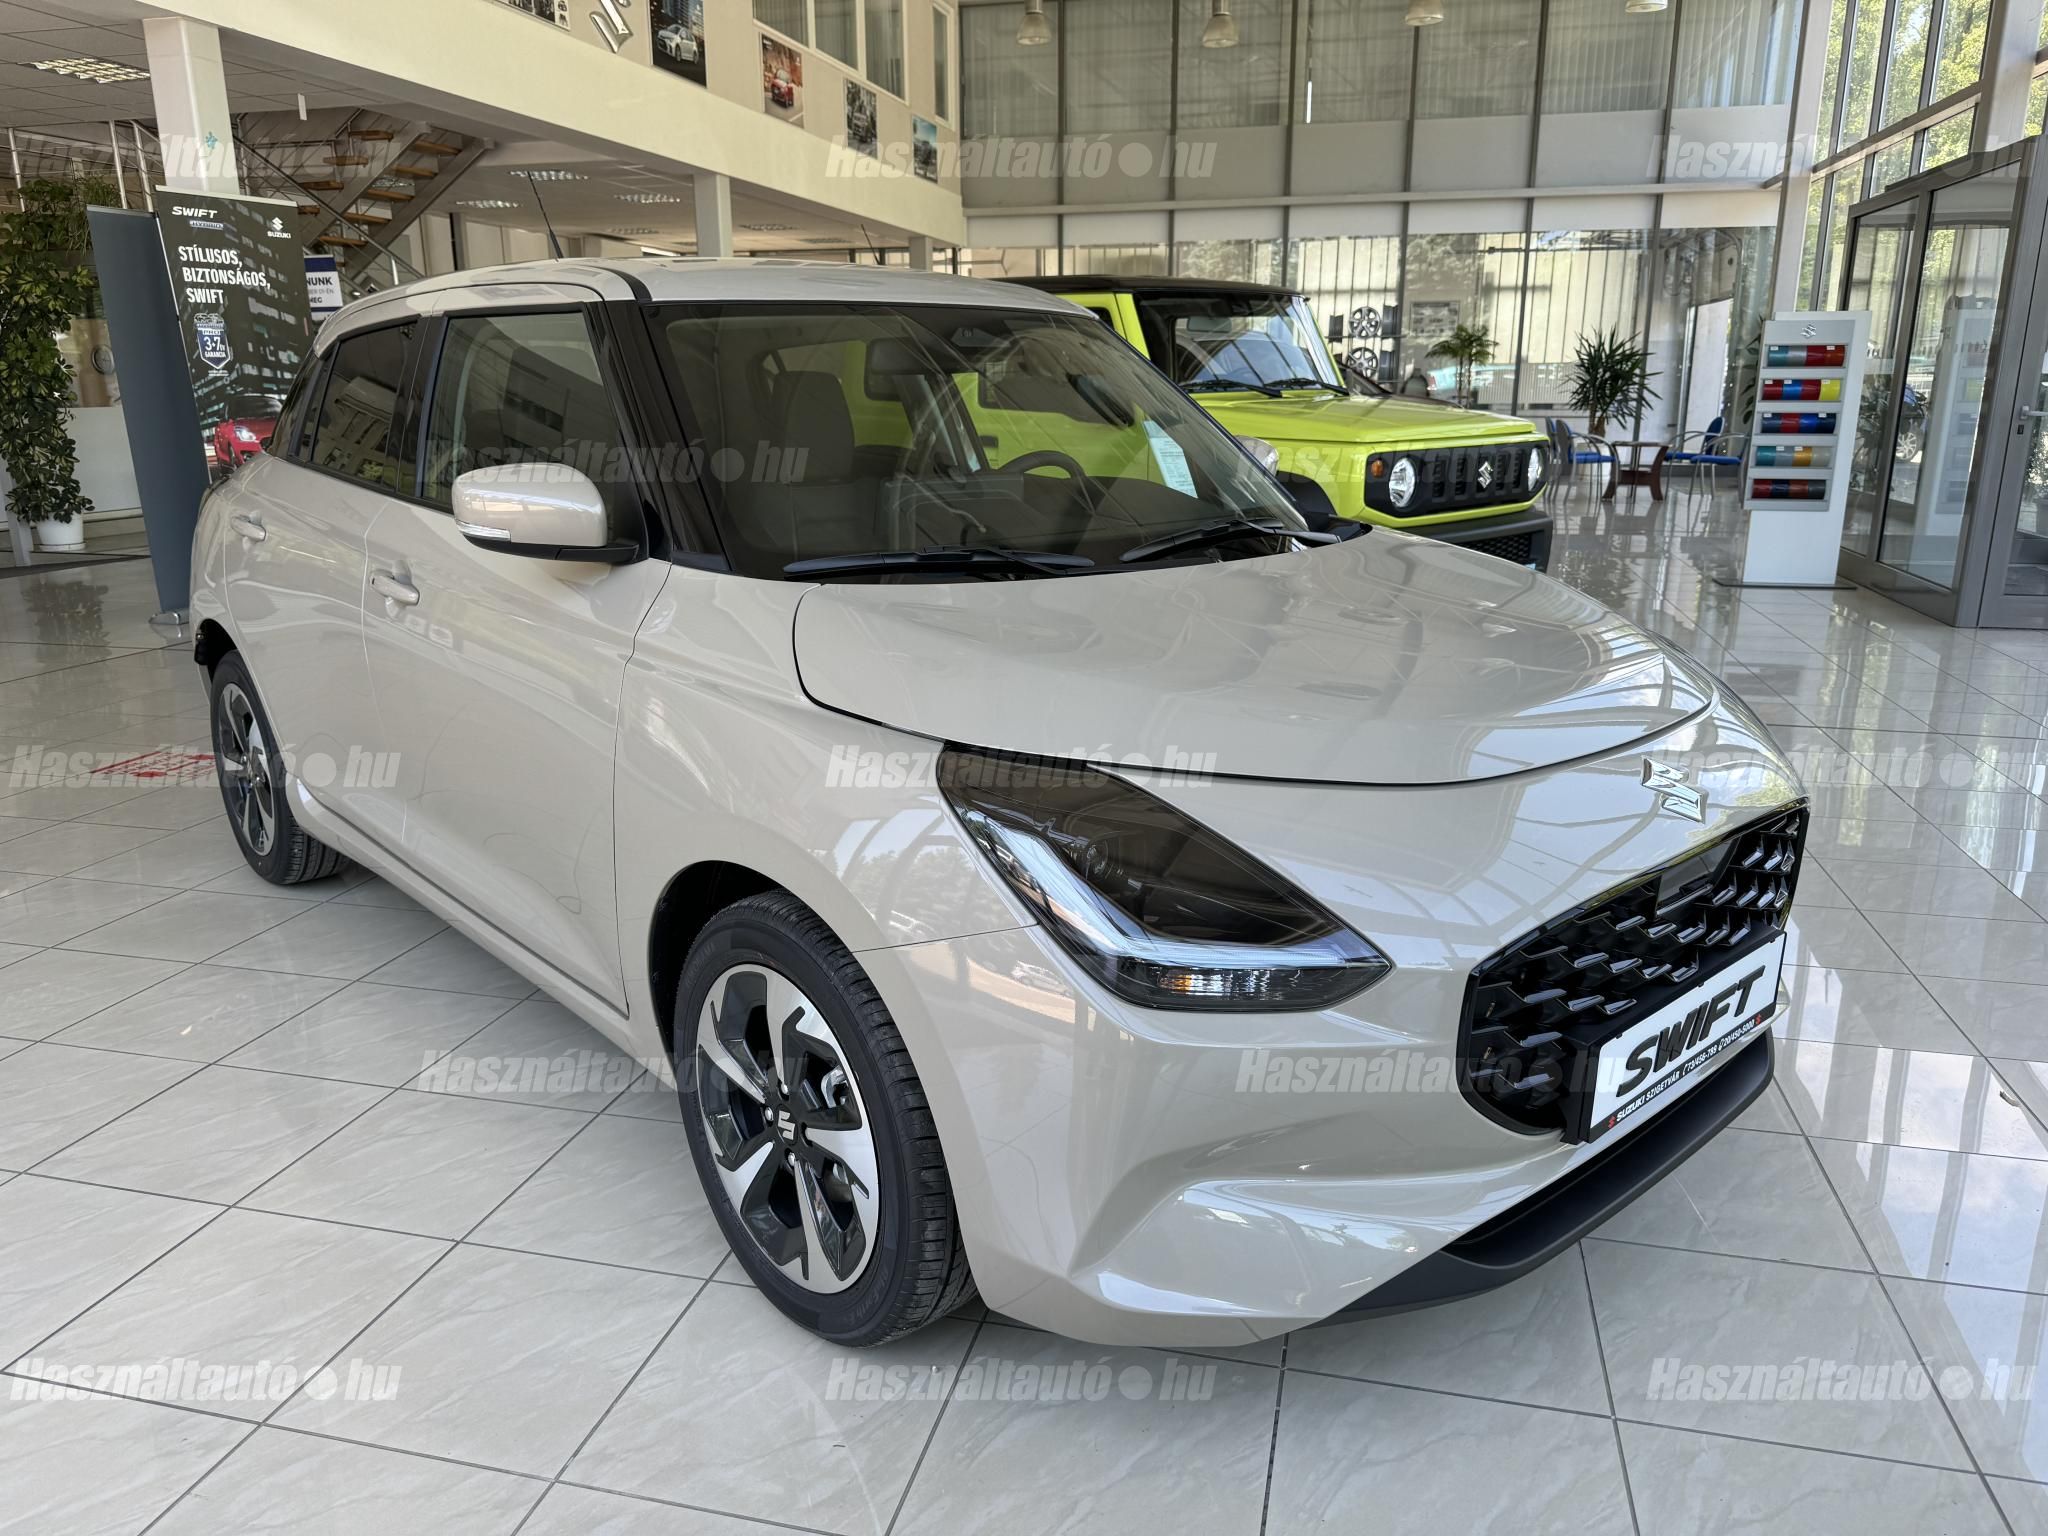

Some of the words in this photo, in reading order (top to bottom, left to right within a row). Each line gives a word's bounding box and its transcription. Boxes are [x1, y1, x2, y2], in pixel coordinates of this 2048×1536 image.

[171, 206, 218, 219] SWIFT
[267, 230, 292, 239] SUZUKI
[178, 244, 243, 268] STÍLUSOS,
[182, 267, 271, 290] BIZTONSÁGOS,
[186, 287, 224, 304] SWIFT
[1616, 965, 1766, 1097] SWIFT
[1616, 1095, 1646, 1121] SUZUKI
[1646, 1071, 1680, 1101] SZIGETVÁR
